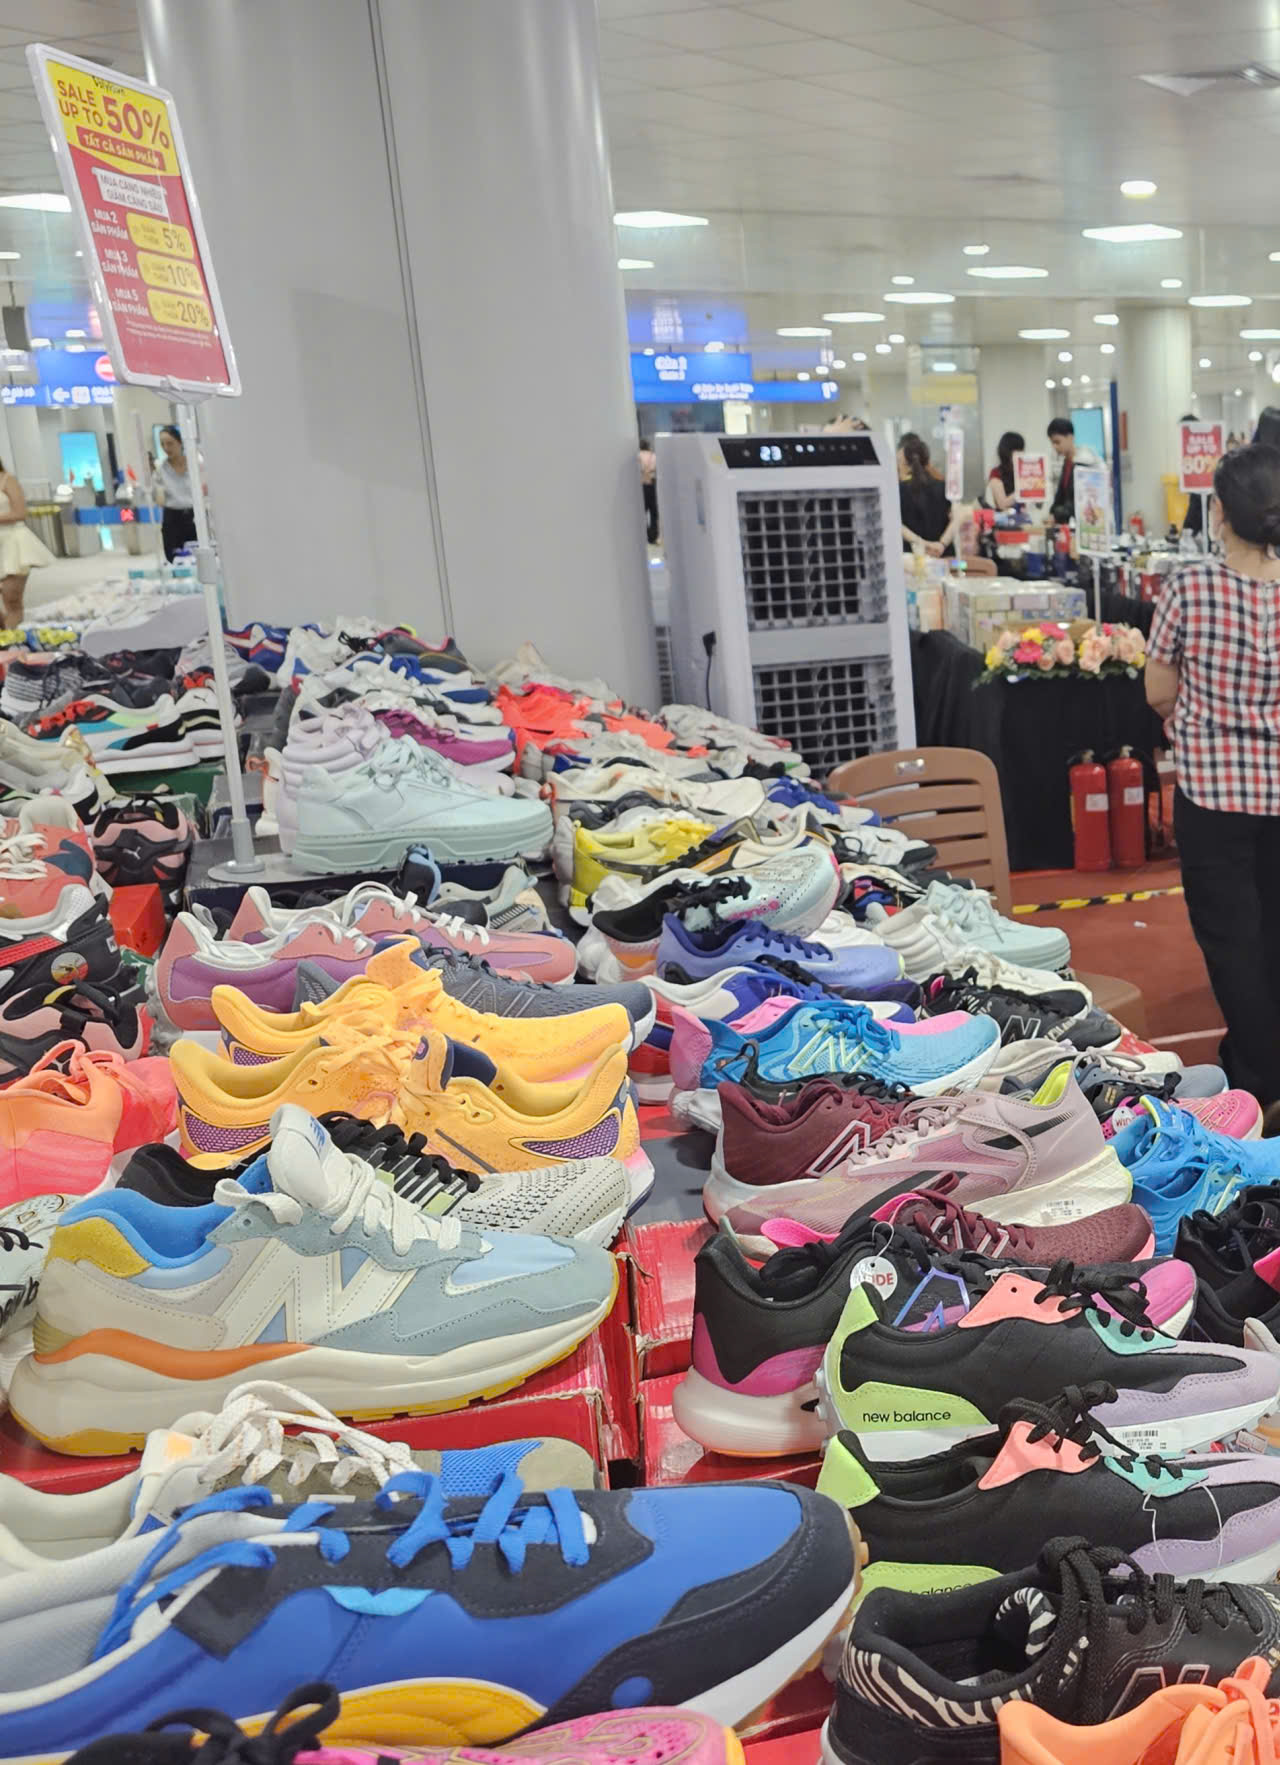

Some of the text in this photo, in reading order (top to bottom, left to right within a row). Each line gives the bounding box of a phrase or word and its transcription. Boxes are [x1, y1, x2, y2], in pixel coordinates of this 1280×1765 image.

[57, 80, 96, 107] SALE
[58, 98, 104, 127] UP TO
[102, 95, 170, 149] 50%
[162, 227, 187, 252] 5%
[176, 300, 210, 327] 20%
[862, 1410, 952, 1423] new balance
